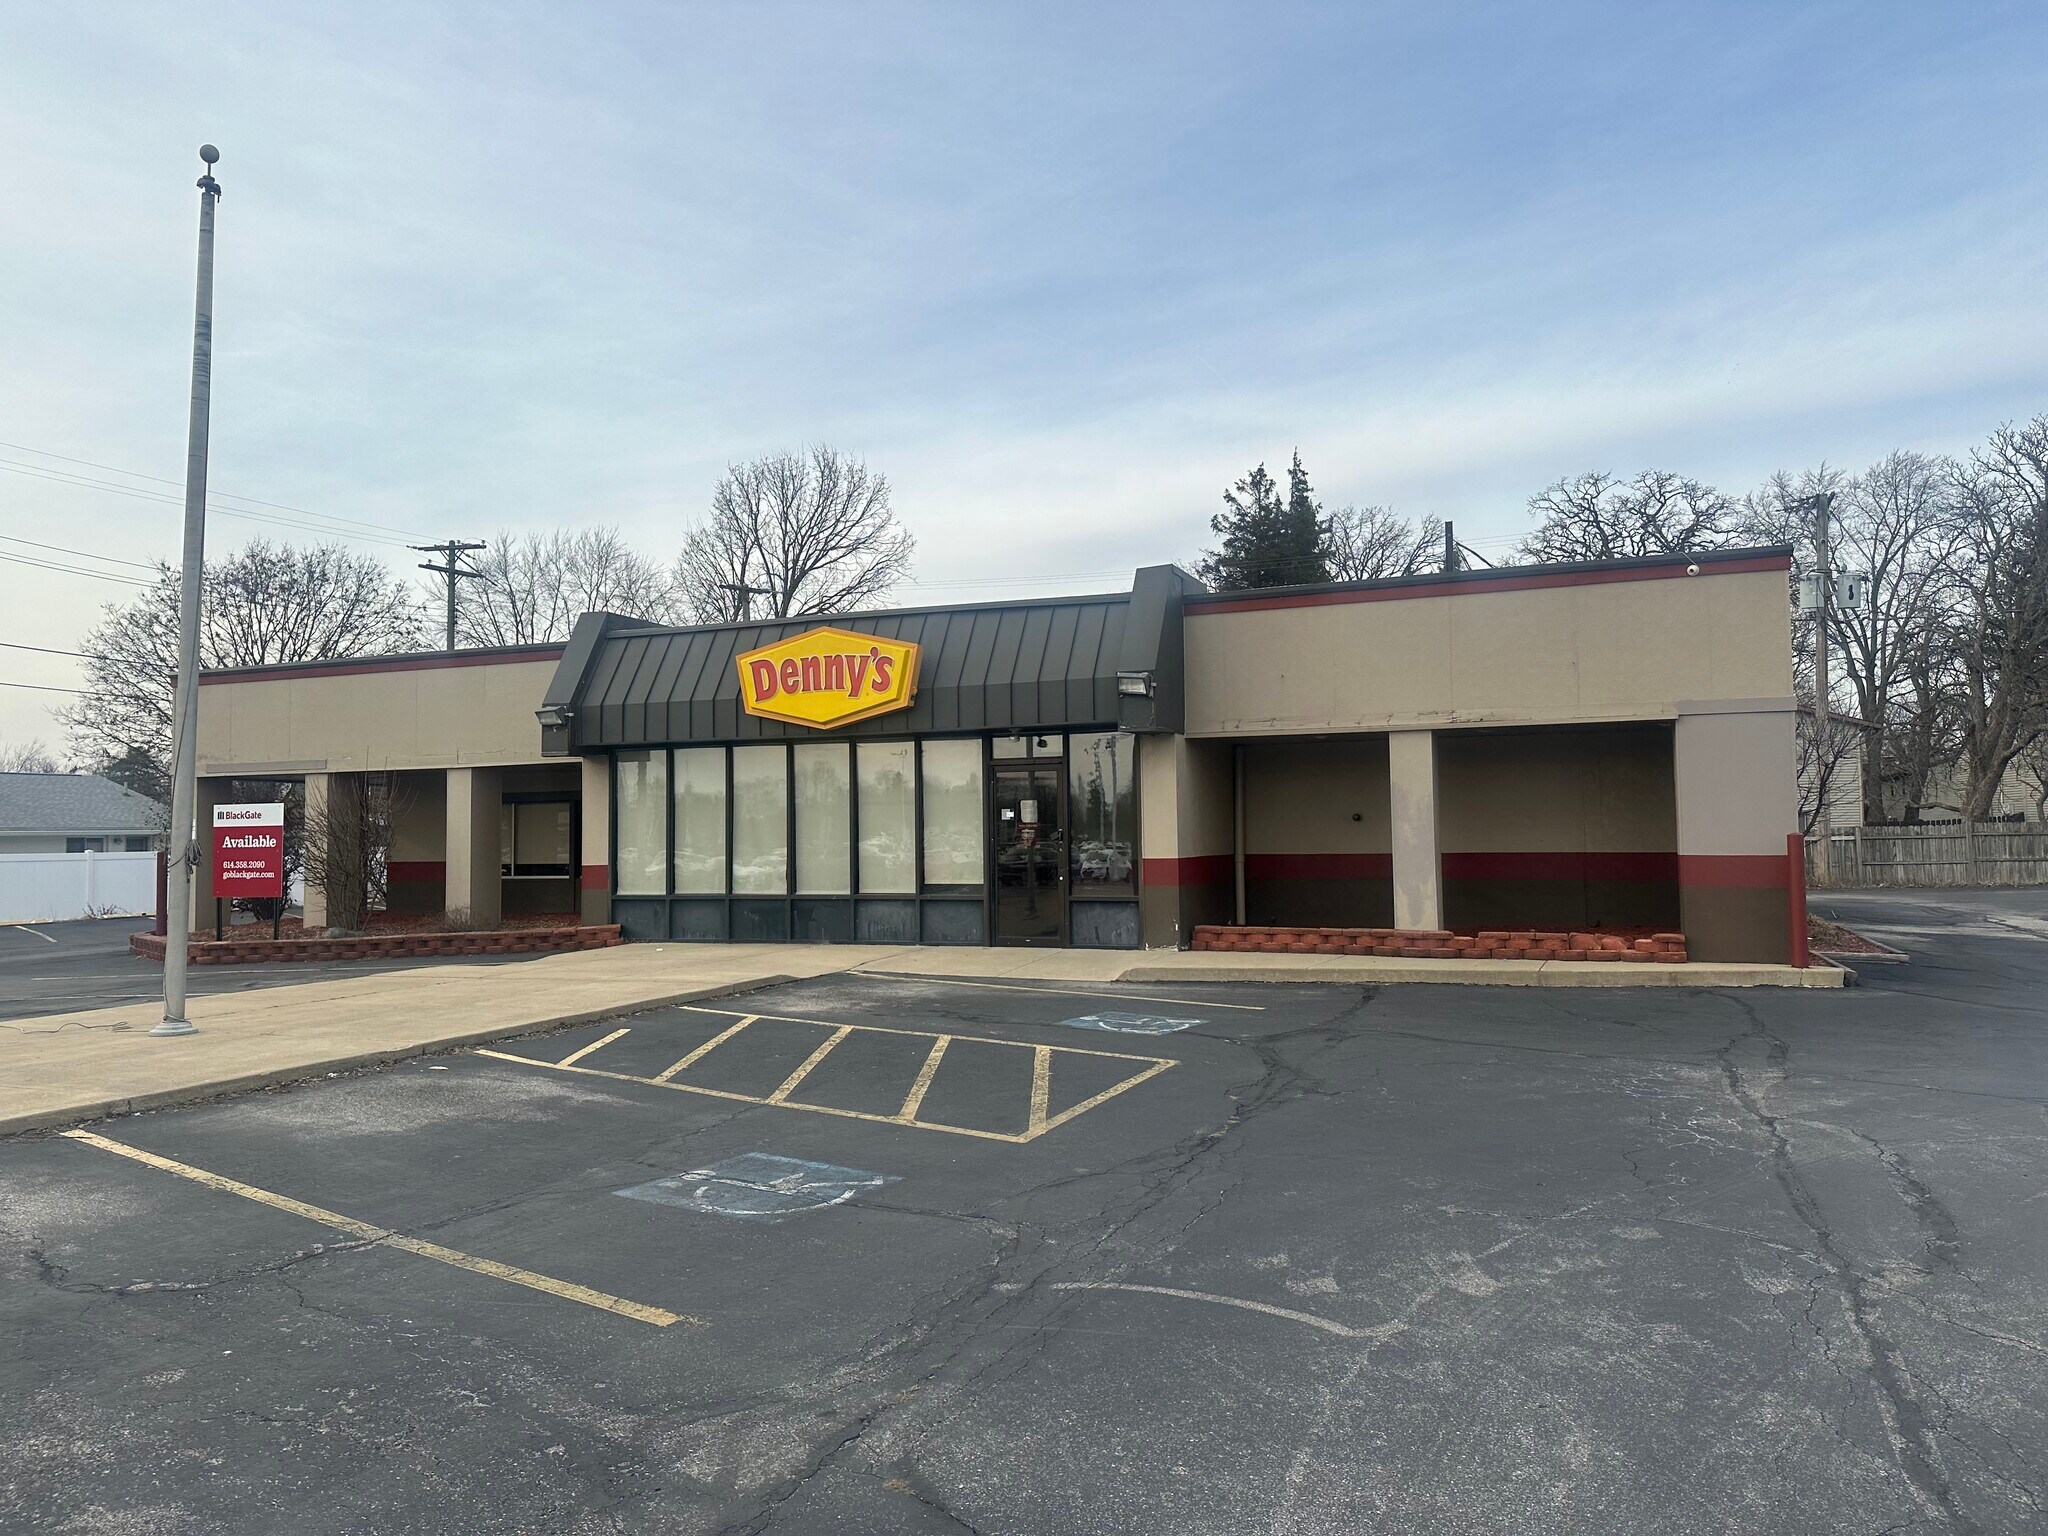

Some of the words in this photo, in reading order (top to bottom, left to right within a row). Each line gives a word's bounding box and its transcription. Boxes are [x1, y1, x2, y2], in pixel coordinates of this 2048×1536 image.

[750, 647, 893, 703] Denny's
[225, 811, 262, 820] BlackGate
[222, 835, 277, 848] Available
[223, 861, 266, 869] 614.358.2090
[223, 870, 275, 880] goblackgate.com
